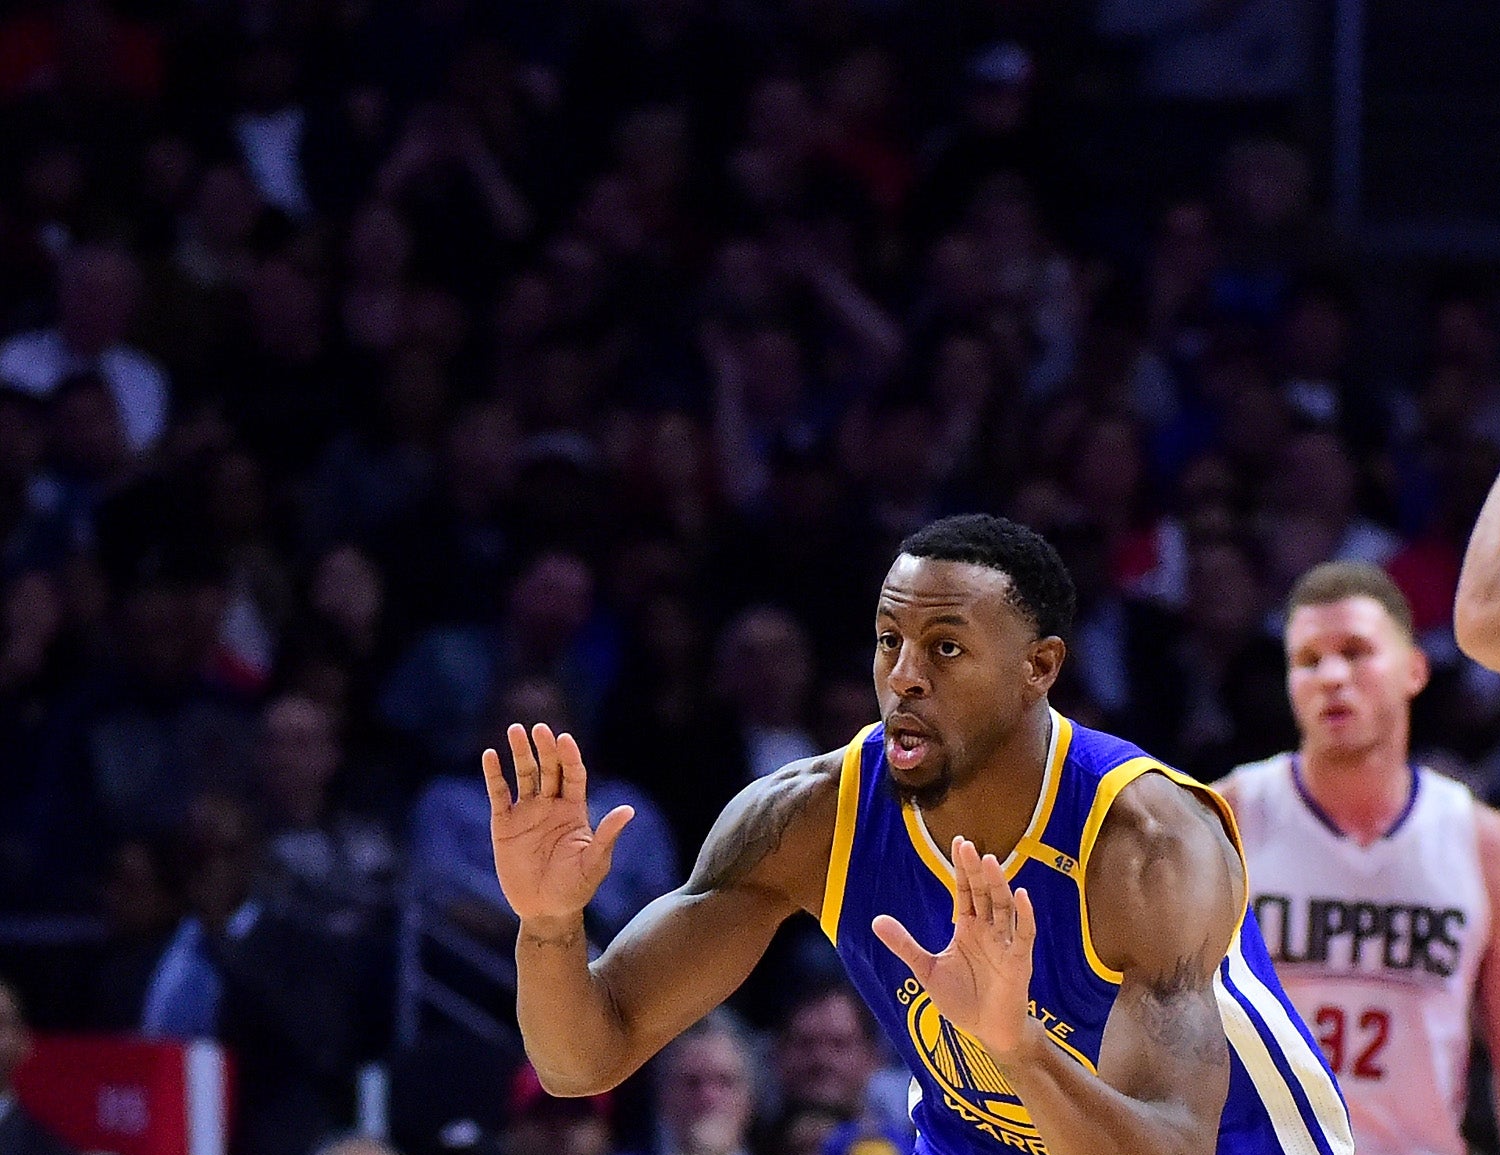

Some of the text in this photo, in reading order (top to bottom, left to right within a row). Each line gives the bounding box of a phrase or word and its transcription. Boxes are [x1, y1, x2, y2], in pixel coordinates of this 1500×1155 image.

[1054, 854, 1075, 873] 42
[1253, 893, 1467, 978] CLIPPERS
[1027, 1000, 1075, 1040] ATE
[1315, 1004, 1392, 1080] 32
